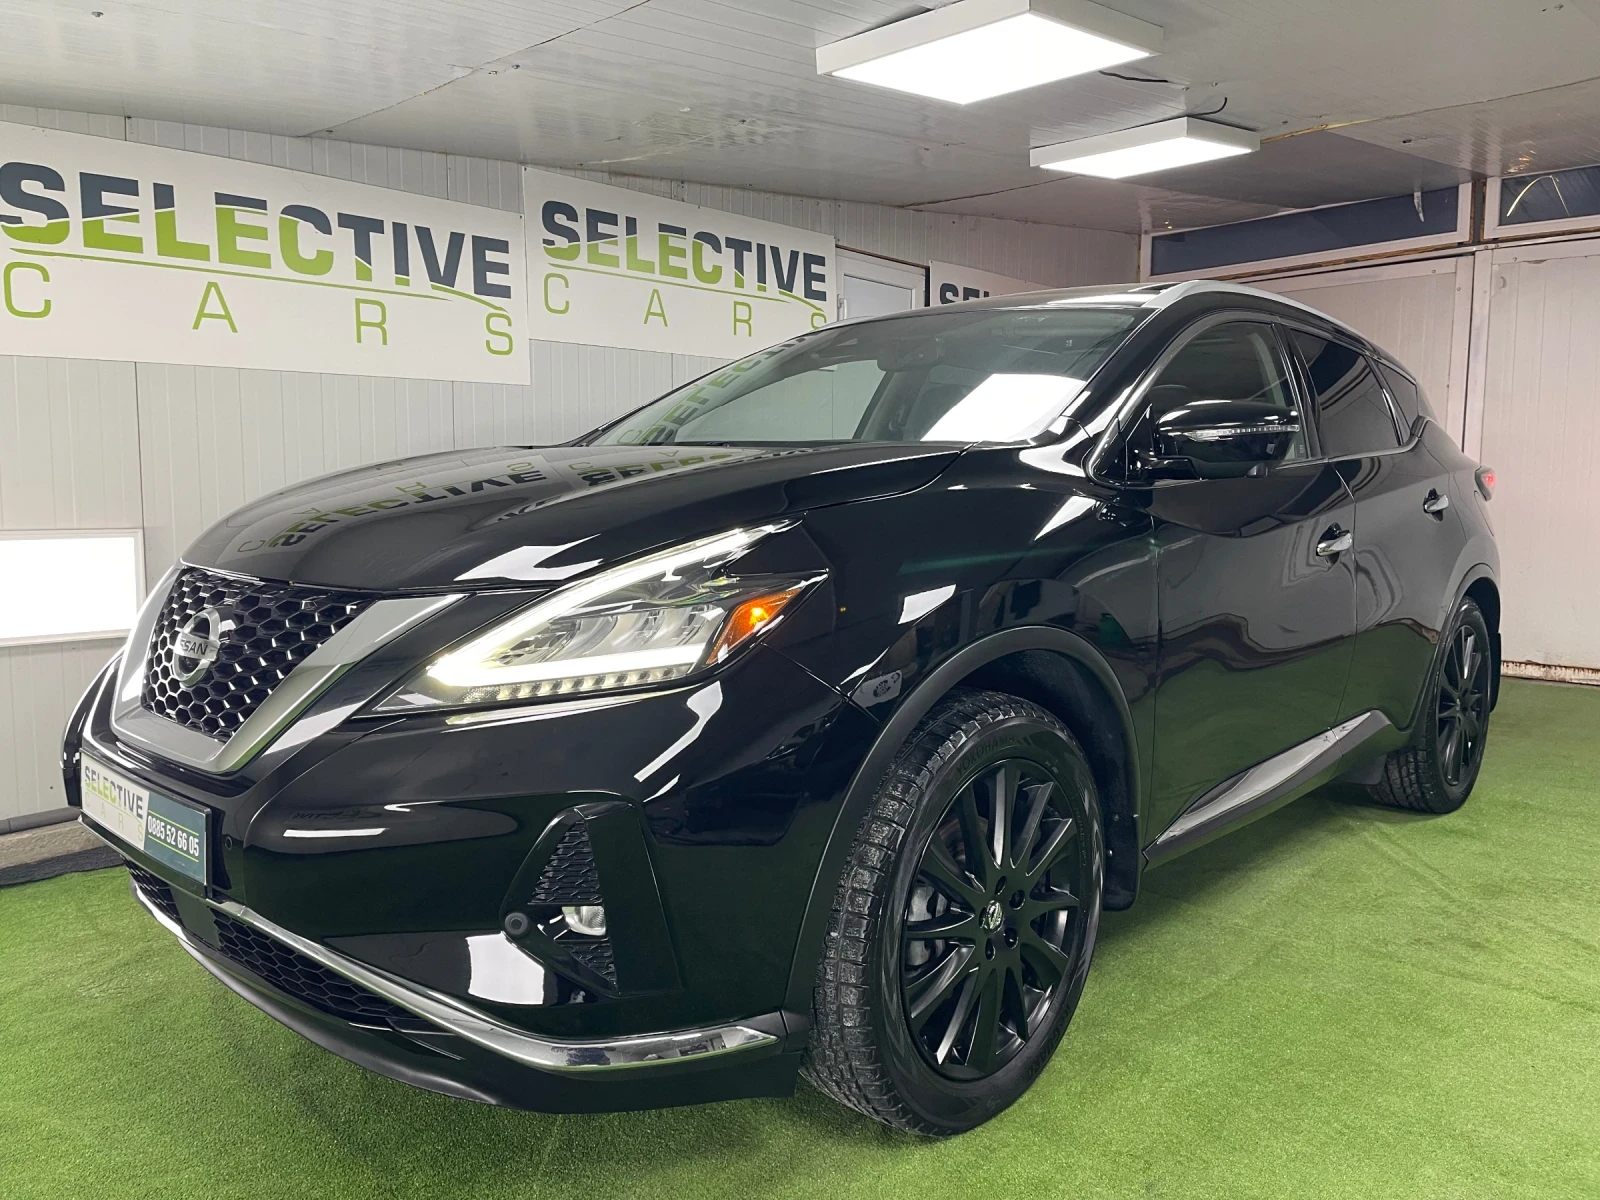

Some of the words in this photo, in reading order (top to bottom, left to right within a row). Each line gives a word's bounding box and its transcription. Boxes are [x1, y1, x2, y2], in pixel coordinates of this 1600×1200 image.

[0, 161, 512, 300] SELECTIVE
[541, 200, 827, 302] SELECTIVE
[3, 262, 514, 356] CARS
[84, 765, 143, 820] SELECTIVE
[956, 735, 1015, 776] YOKOHAMA
[147, 815, 166, 840] 0885
[166, 824, 176, 845] 52
[177, 829, 188, 852] 66
[188, 835, 199, 857] 05
